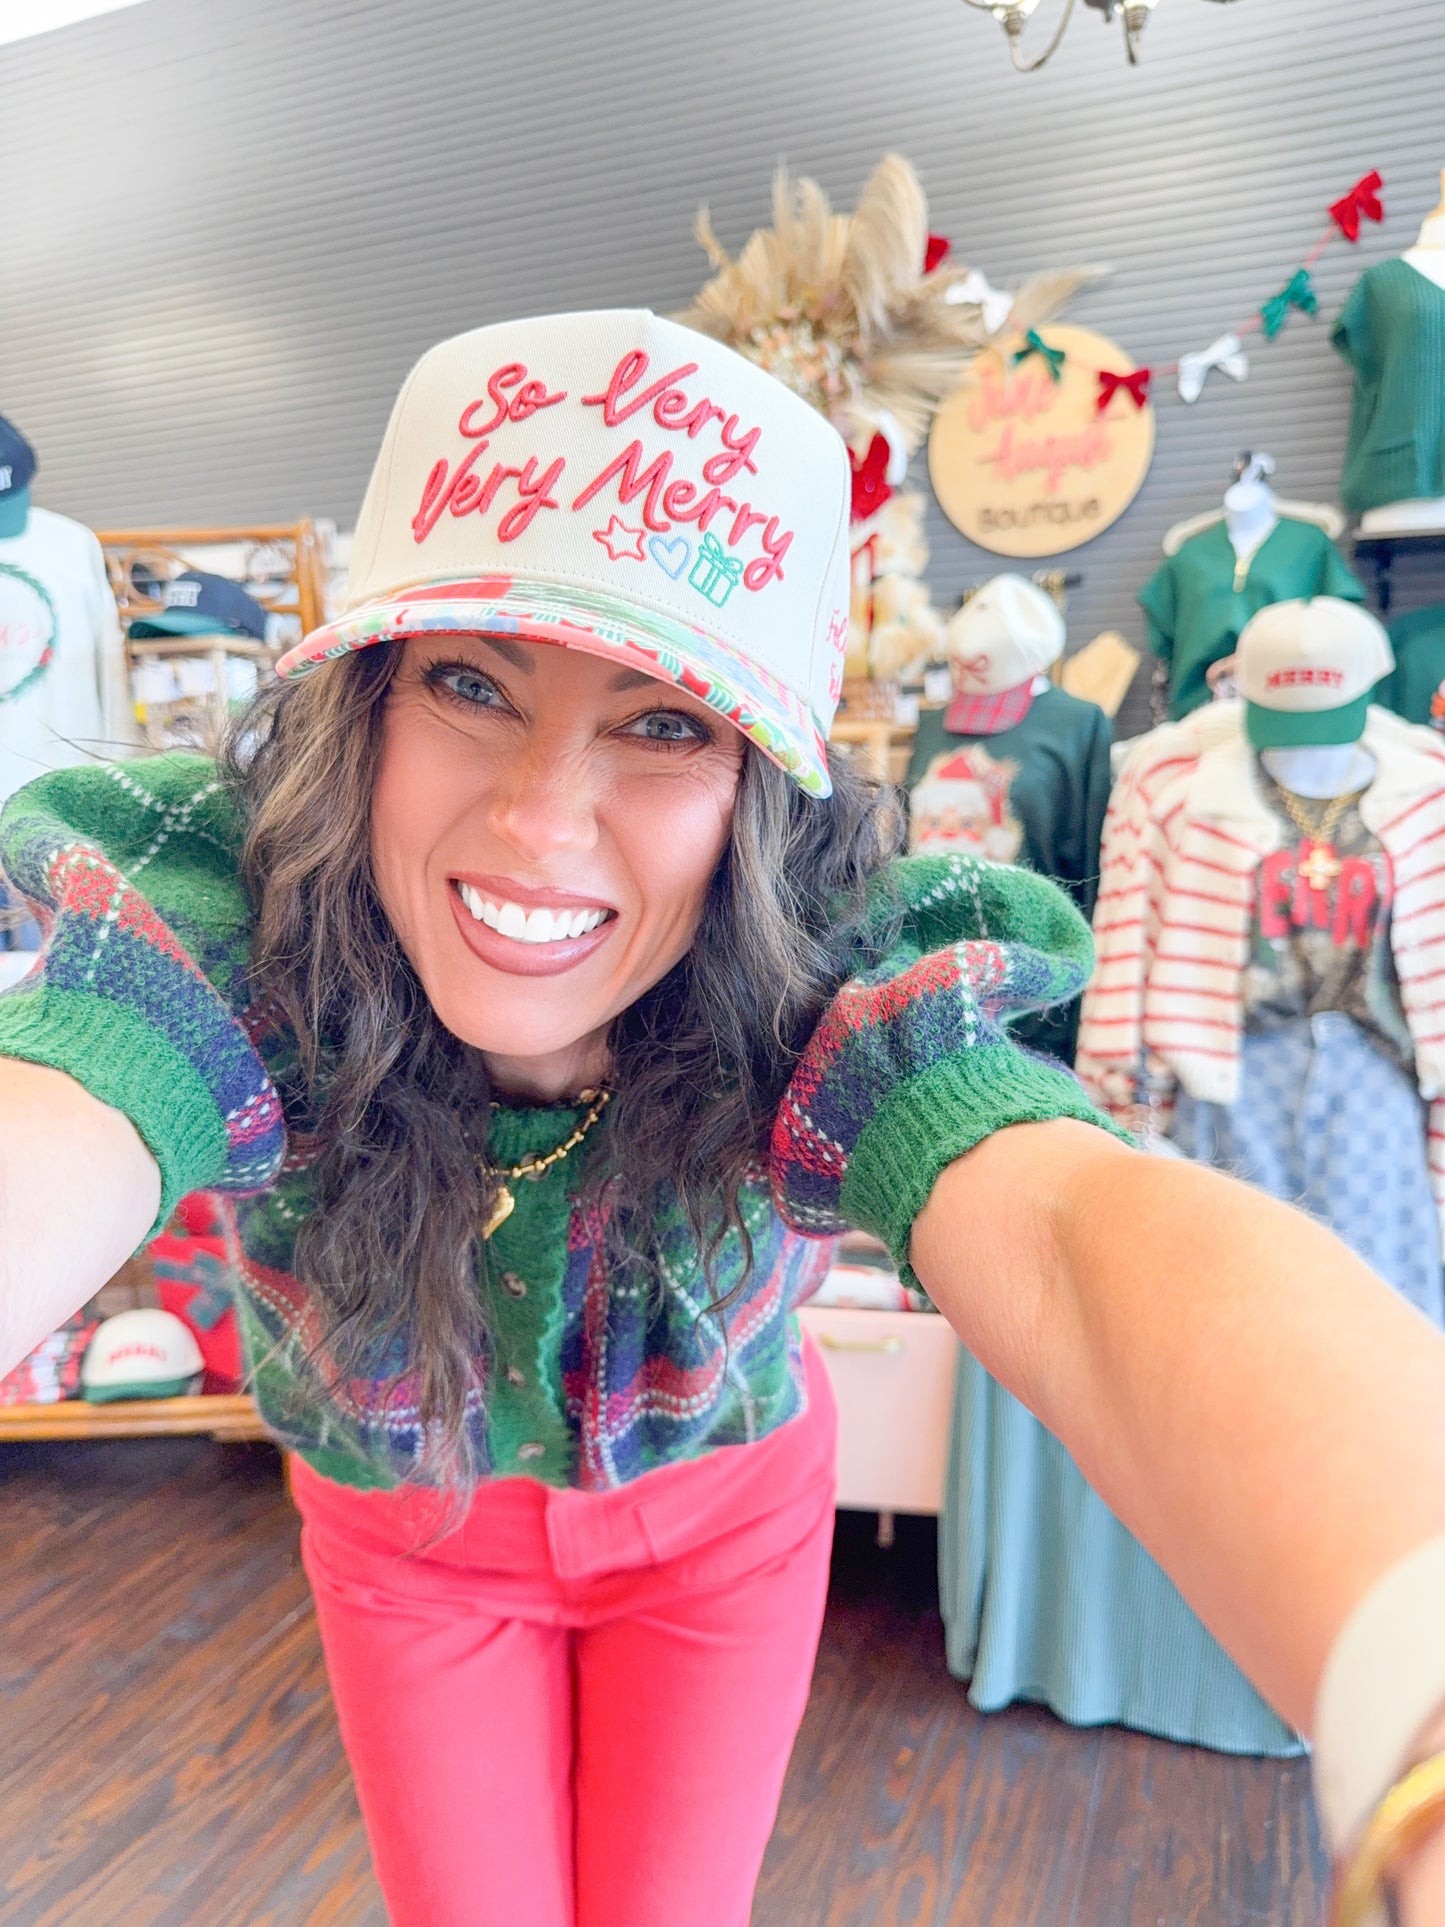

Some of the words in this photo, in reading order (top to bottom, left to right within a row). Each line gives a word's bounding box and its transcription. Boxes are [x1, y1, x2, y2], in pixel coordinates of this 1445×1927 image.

[459, 363, 567, 438] So
[581, 349, 762, 485] Very
[411, 439, 566, 544] Very
[573, 439, 794, 592] Merry
[977, 498, 1101, 532] BOUTIQUE
